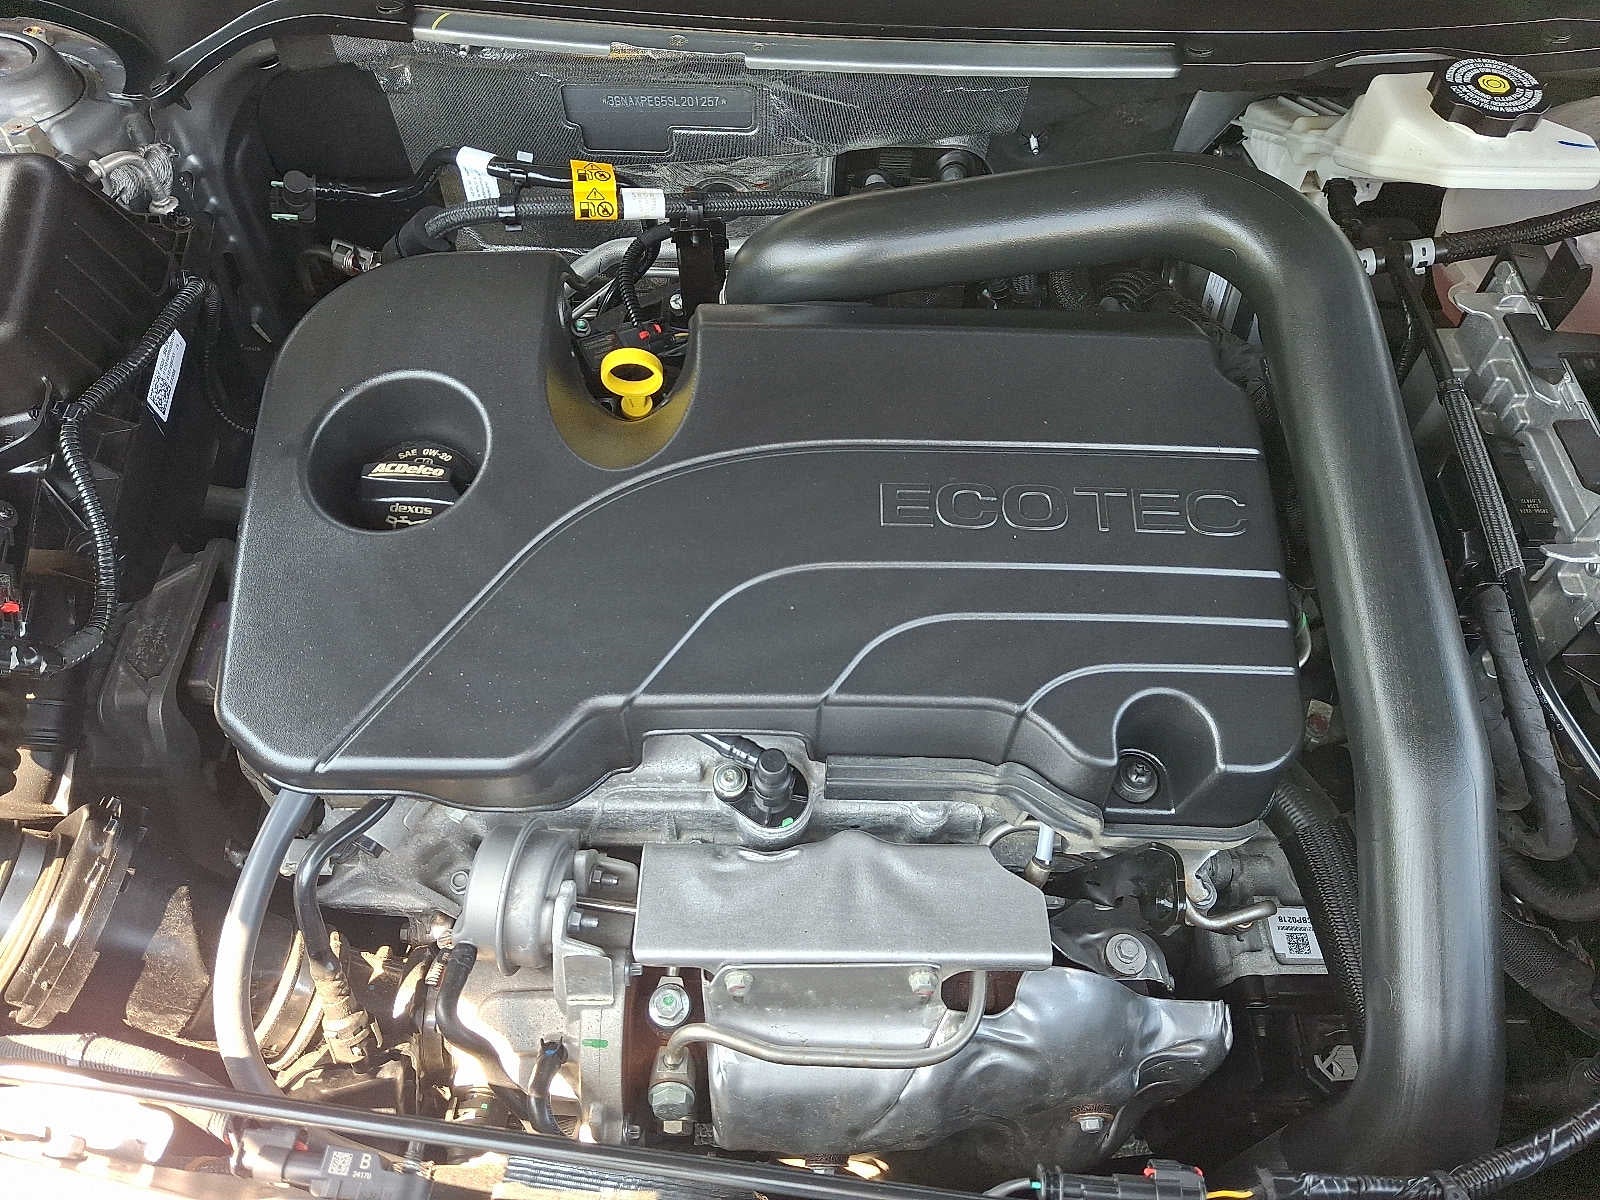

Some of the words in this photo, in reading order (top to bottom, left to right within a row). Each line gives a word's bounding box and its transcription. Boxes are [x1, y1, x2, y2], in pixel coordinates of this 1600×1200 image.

[398, 449, 418, 460] SAE
[422, 448, 453, 462] 0W-20
[370, 462, 445, 477] ACDelco
[389, 502, 433, 515] dexos
[880, 482, 1248, 537] ECOTEC
[360, 1153, 372, 1170] B
